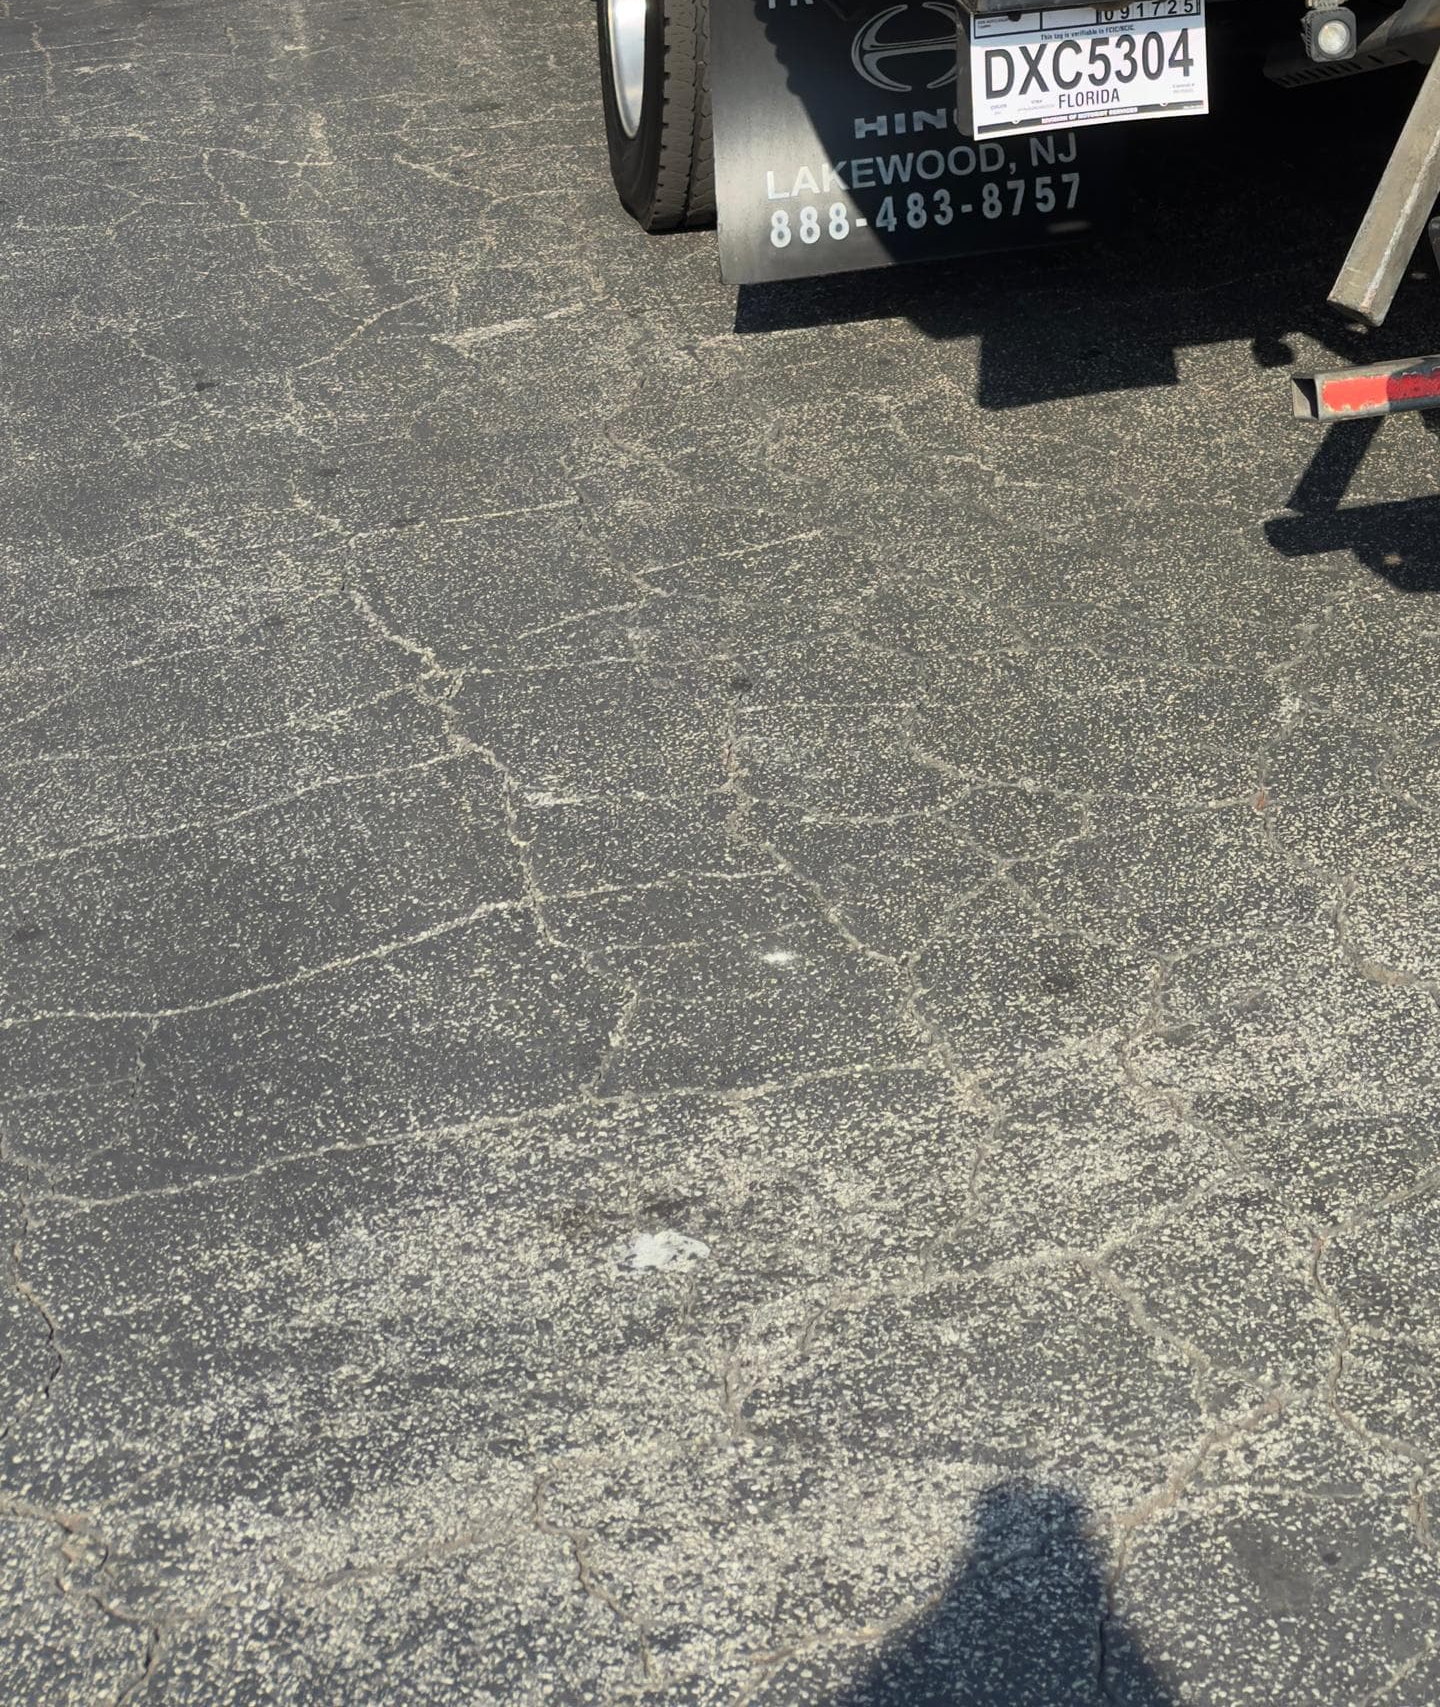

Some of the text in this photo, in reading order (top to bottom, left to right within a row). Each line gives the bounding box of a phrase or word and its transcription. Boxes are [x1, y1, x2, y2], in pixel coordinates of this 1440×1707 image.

[984, 27, 1195, 101] DXC5304
[1058, 87, 1121, 109] FLORIDA
[854, 107, 959, 139] HIN
[766, 132, 1078, 200] LAKEWOOD, NJ
[770, 172, 1081, 249] 888-483-8757
